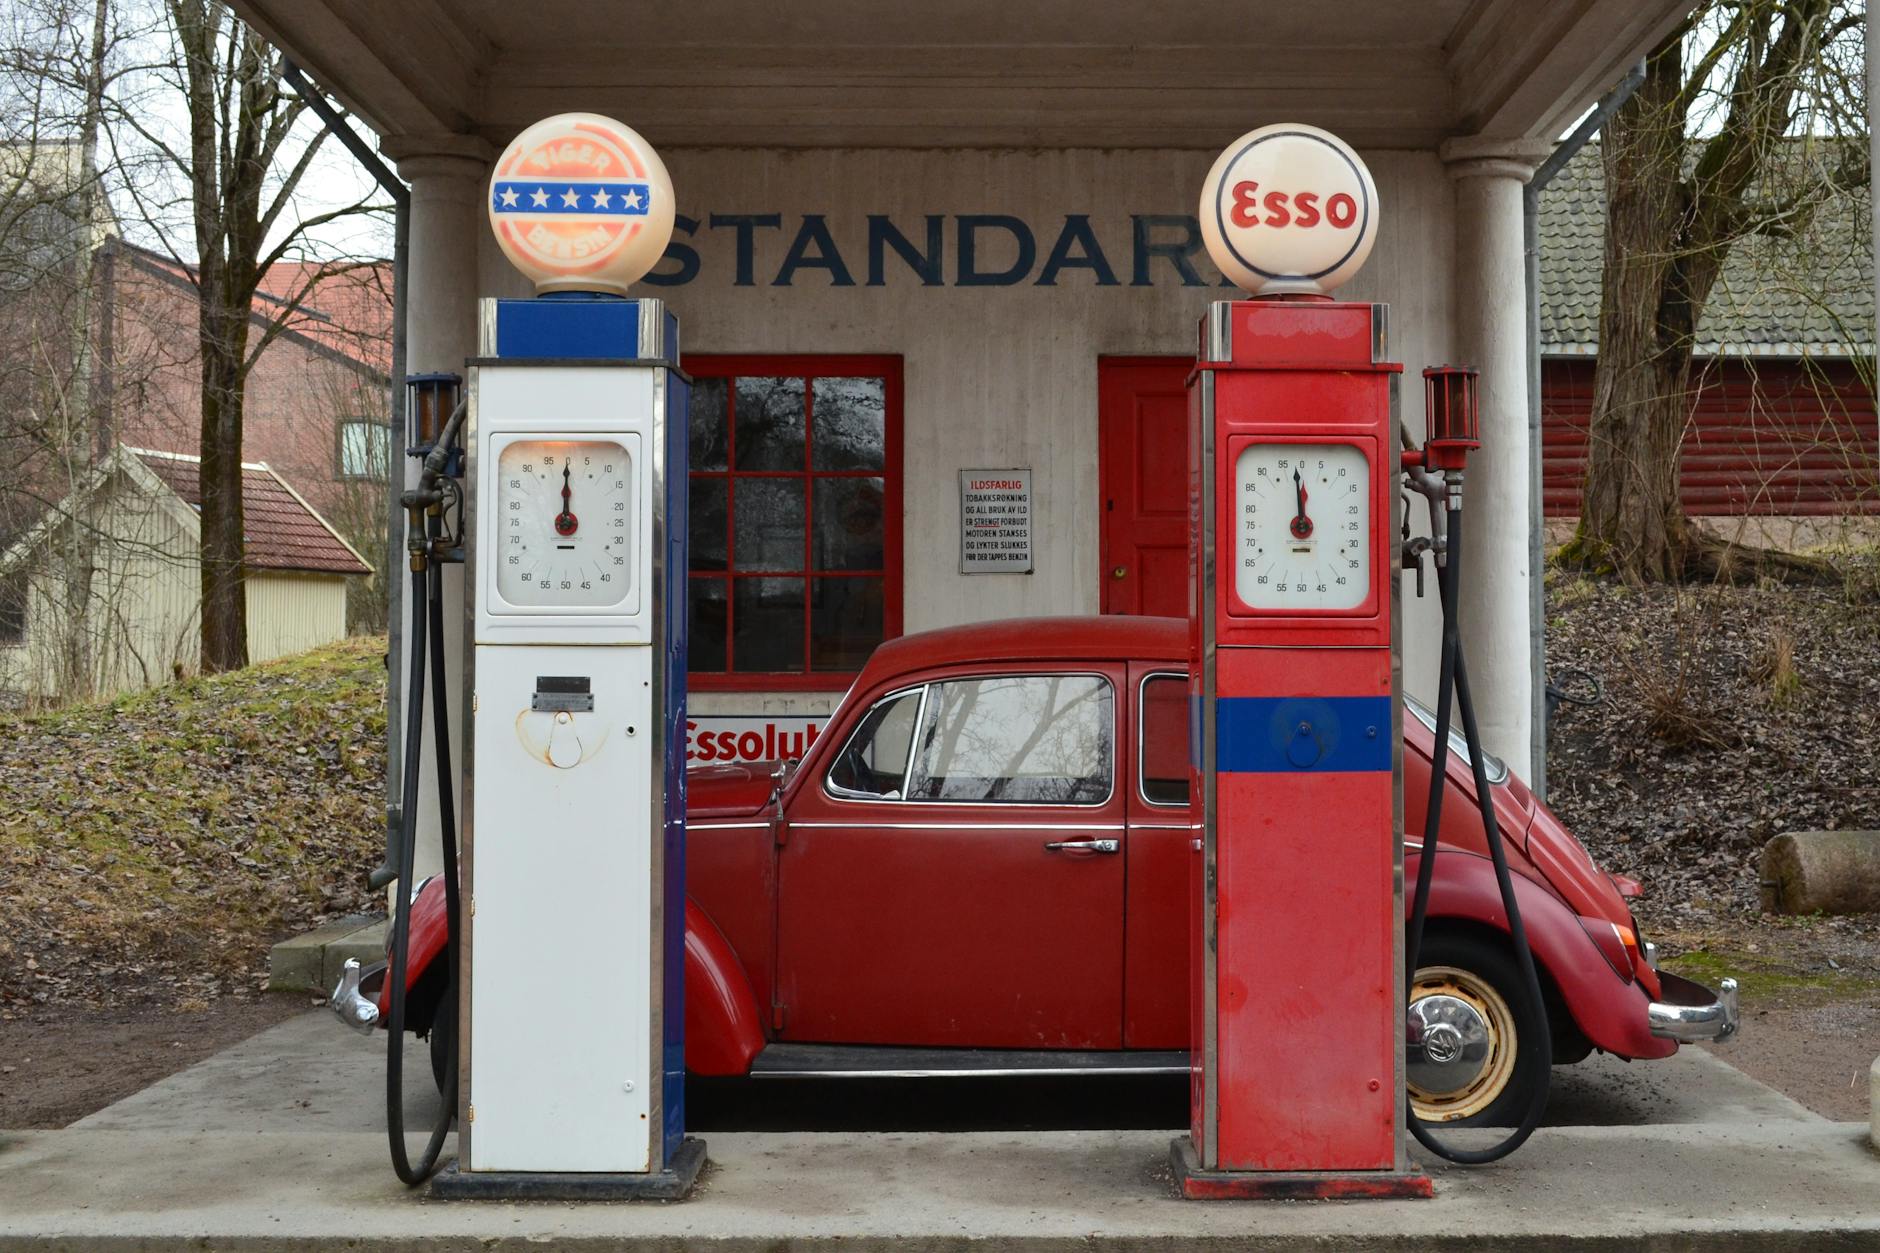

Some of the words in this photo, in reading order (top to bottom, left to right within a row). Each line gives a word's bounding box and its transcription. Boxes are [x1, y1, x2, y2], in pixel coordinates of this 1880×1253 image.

[531, 142, 611, 174] TIGER
[640, 212, 1237, 287] STANDAR
[565, 456, 571, 465] 0
[584, 456, 590, 465] 5
[1299, 460, 1305, 469] 0
[1318, 460, 1324, 469] 5
[604, 464, 613, 473] 10
[1337, 468, 1346, 477] 10
[615, 480, 624, 489] 15
[970, 480, 1022, 490] ILDSFARLIG
[1349, 484, 1358, 493] 15
[614, 502, 625, 511] 20
[965, 506, 974, 514] OG
[976, 506, 987, 514] ALL
[988, 506, 1007, 514] BRUK
[1007, 506, 1016, 514] AV
[1017, 506, 1027, 514] ILD
[1348, 506, 1359, 515] 20
[509, 518, 520, 527] 75
[614, 518, 625, 527] 25
[965, 518, 973, 526] ER
[974, 518, 1000, 526] STRENGT
[1000, 518, 1027, 526] FORBUDT
[1245, 521, 1256, 530] 75
[1349, 522, 1359, 531] 25
[509, 535, 520, 544] 70
[613, 536, 624, 545] 30
[1245, 538, 1256, 547] 70
[1349, 539, 1359, 548] 30
[508, 556, 519, 565] 65
[613, 556, 624, 565] 35
[1245, 558, 1255, 567] 65
[1349, 560, 1359, 569] 35
[521, 573, 532, 582] 60
[600, 573, 611, 582] 40
[1257, 575, 1268, 584] 60
[1335, 576, 1346, 585] 40
[540, 581, 551, 590] 55
[560, 581, 571, 590] 50
[580, 581, 591, 590] 45
[1276, 583, 1287, 592] 55
[1296, 583, 1307, 592] 50
[1316, 584, 1327, 593] 45
